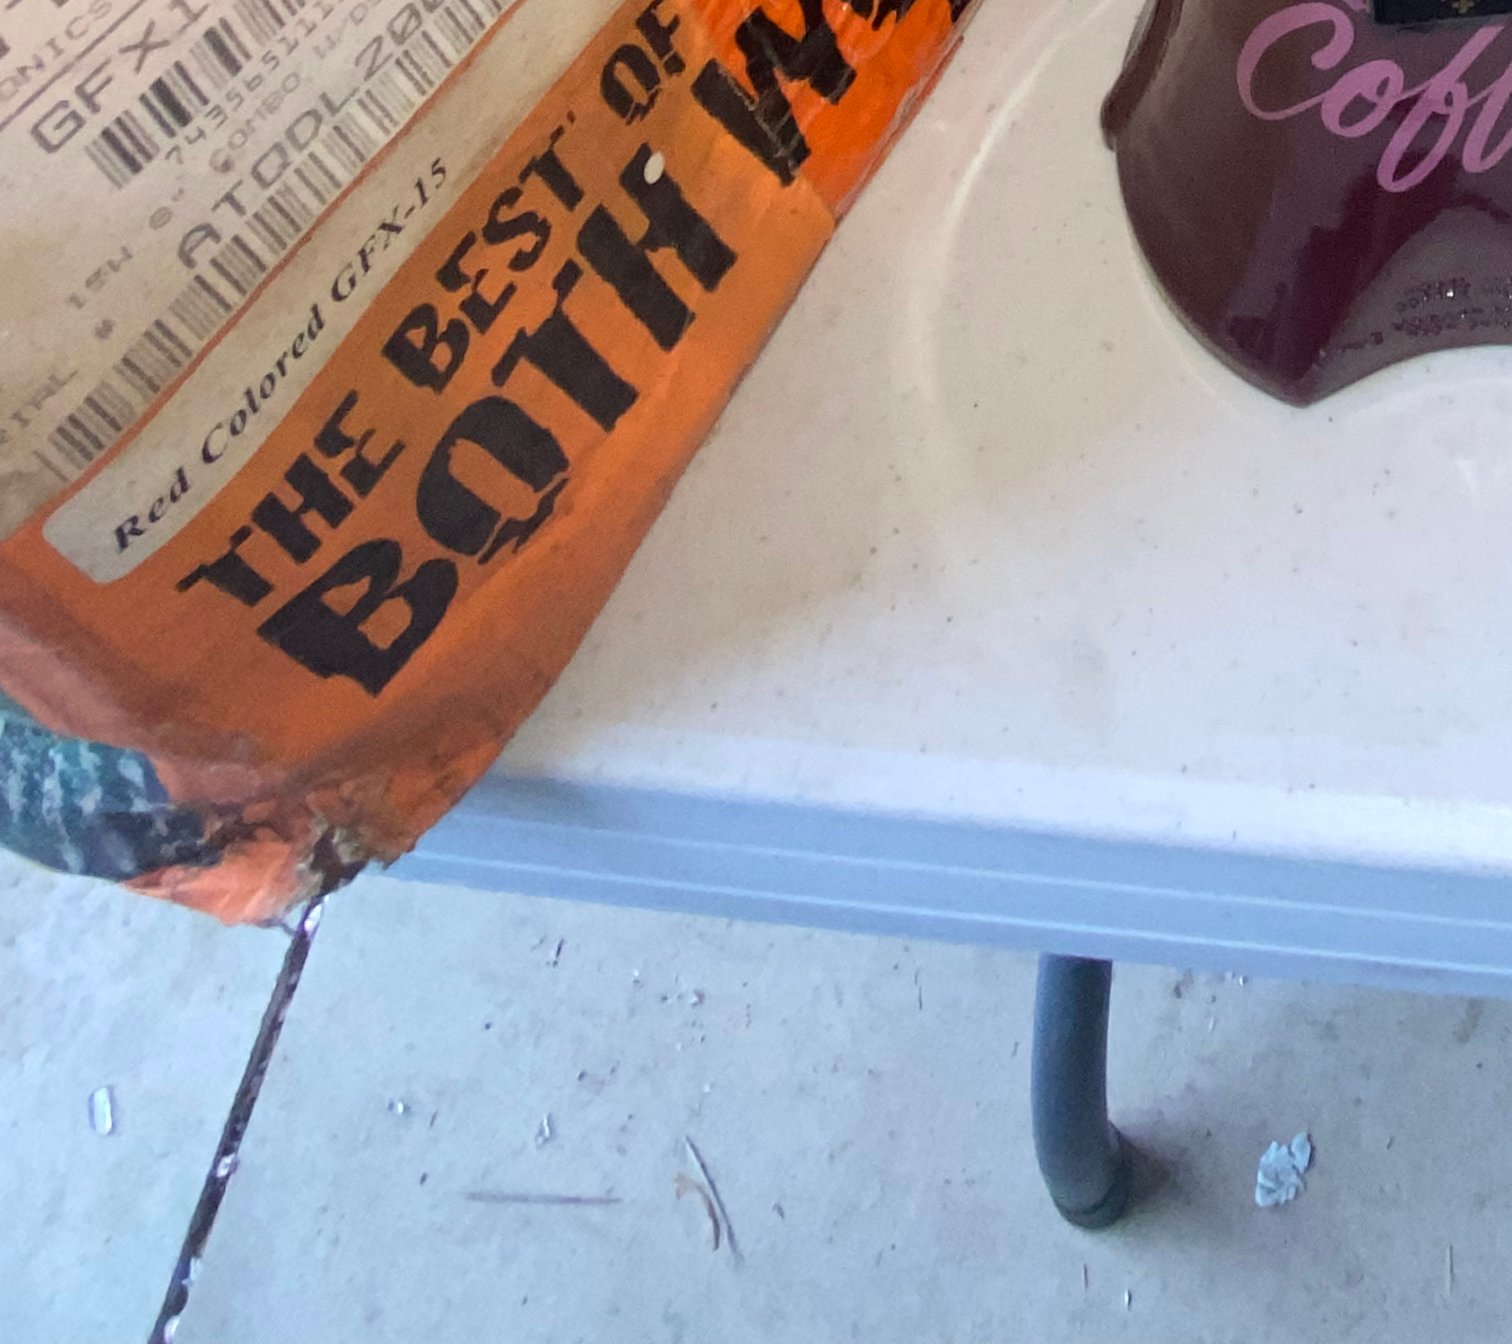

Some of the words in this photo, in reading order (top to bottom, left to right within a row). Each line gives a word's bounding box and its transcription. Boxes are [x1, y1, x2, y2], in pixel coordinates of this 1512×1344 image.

[112, 466, 193, 554] Red
[200, 303, 326, 465] Colored
[329, 155, 448, 305] GFX-15
[176, 389, 406, 608] THE
[379, 110, 590, 395] BEST
[256, 141, 739, 697] BOTH
